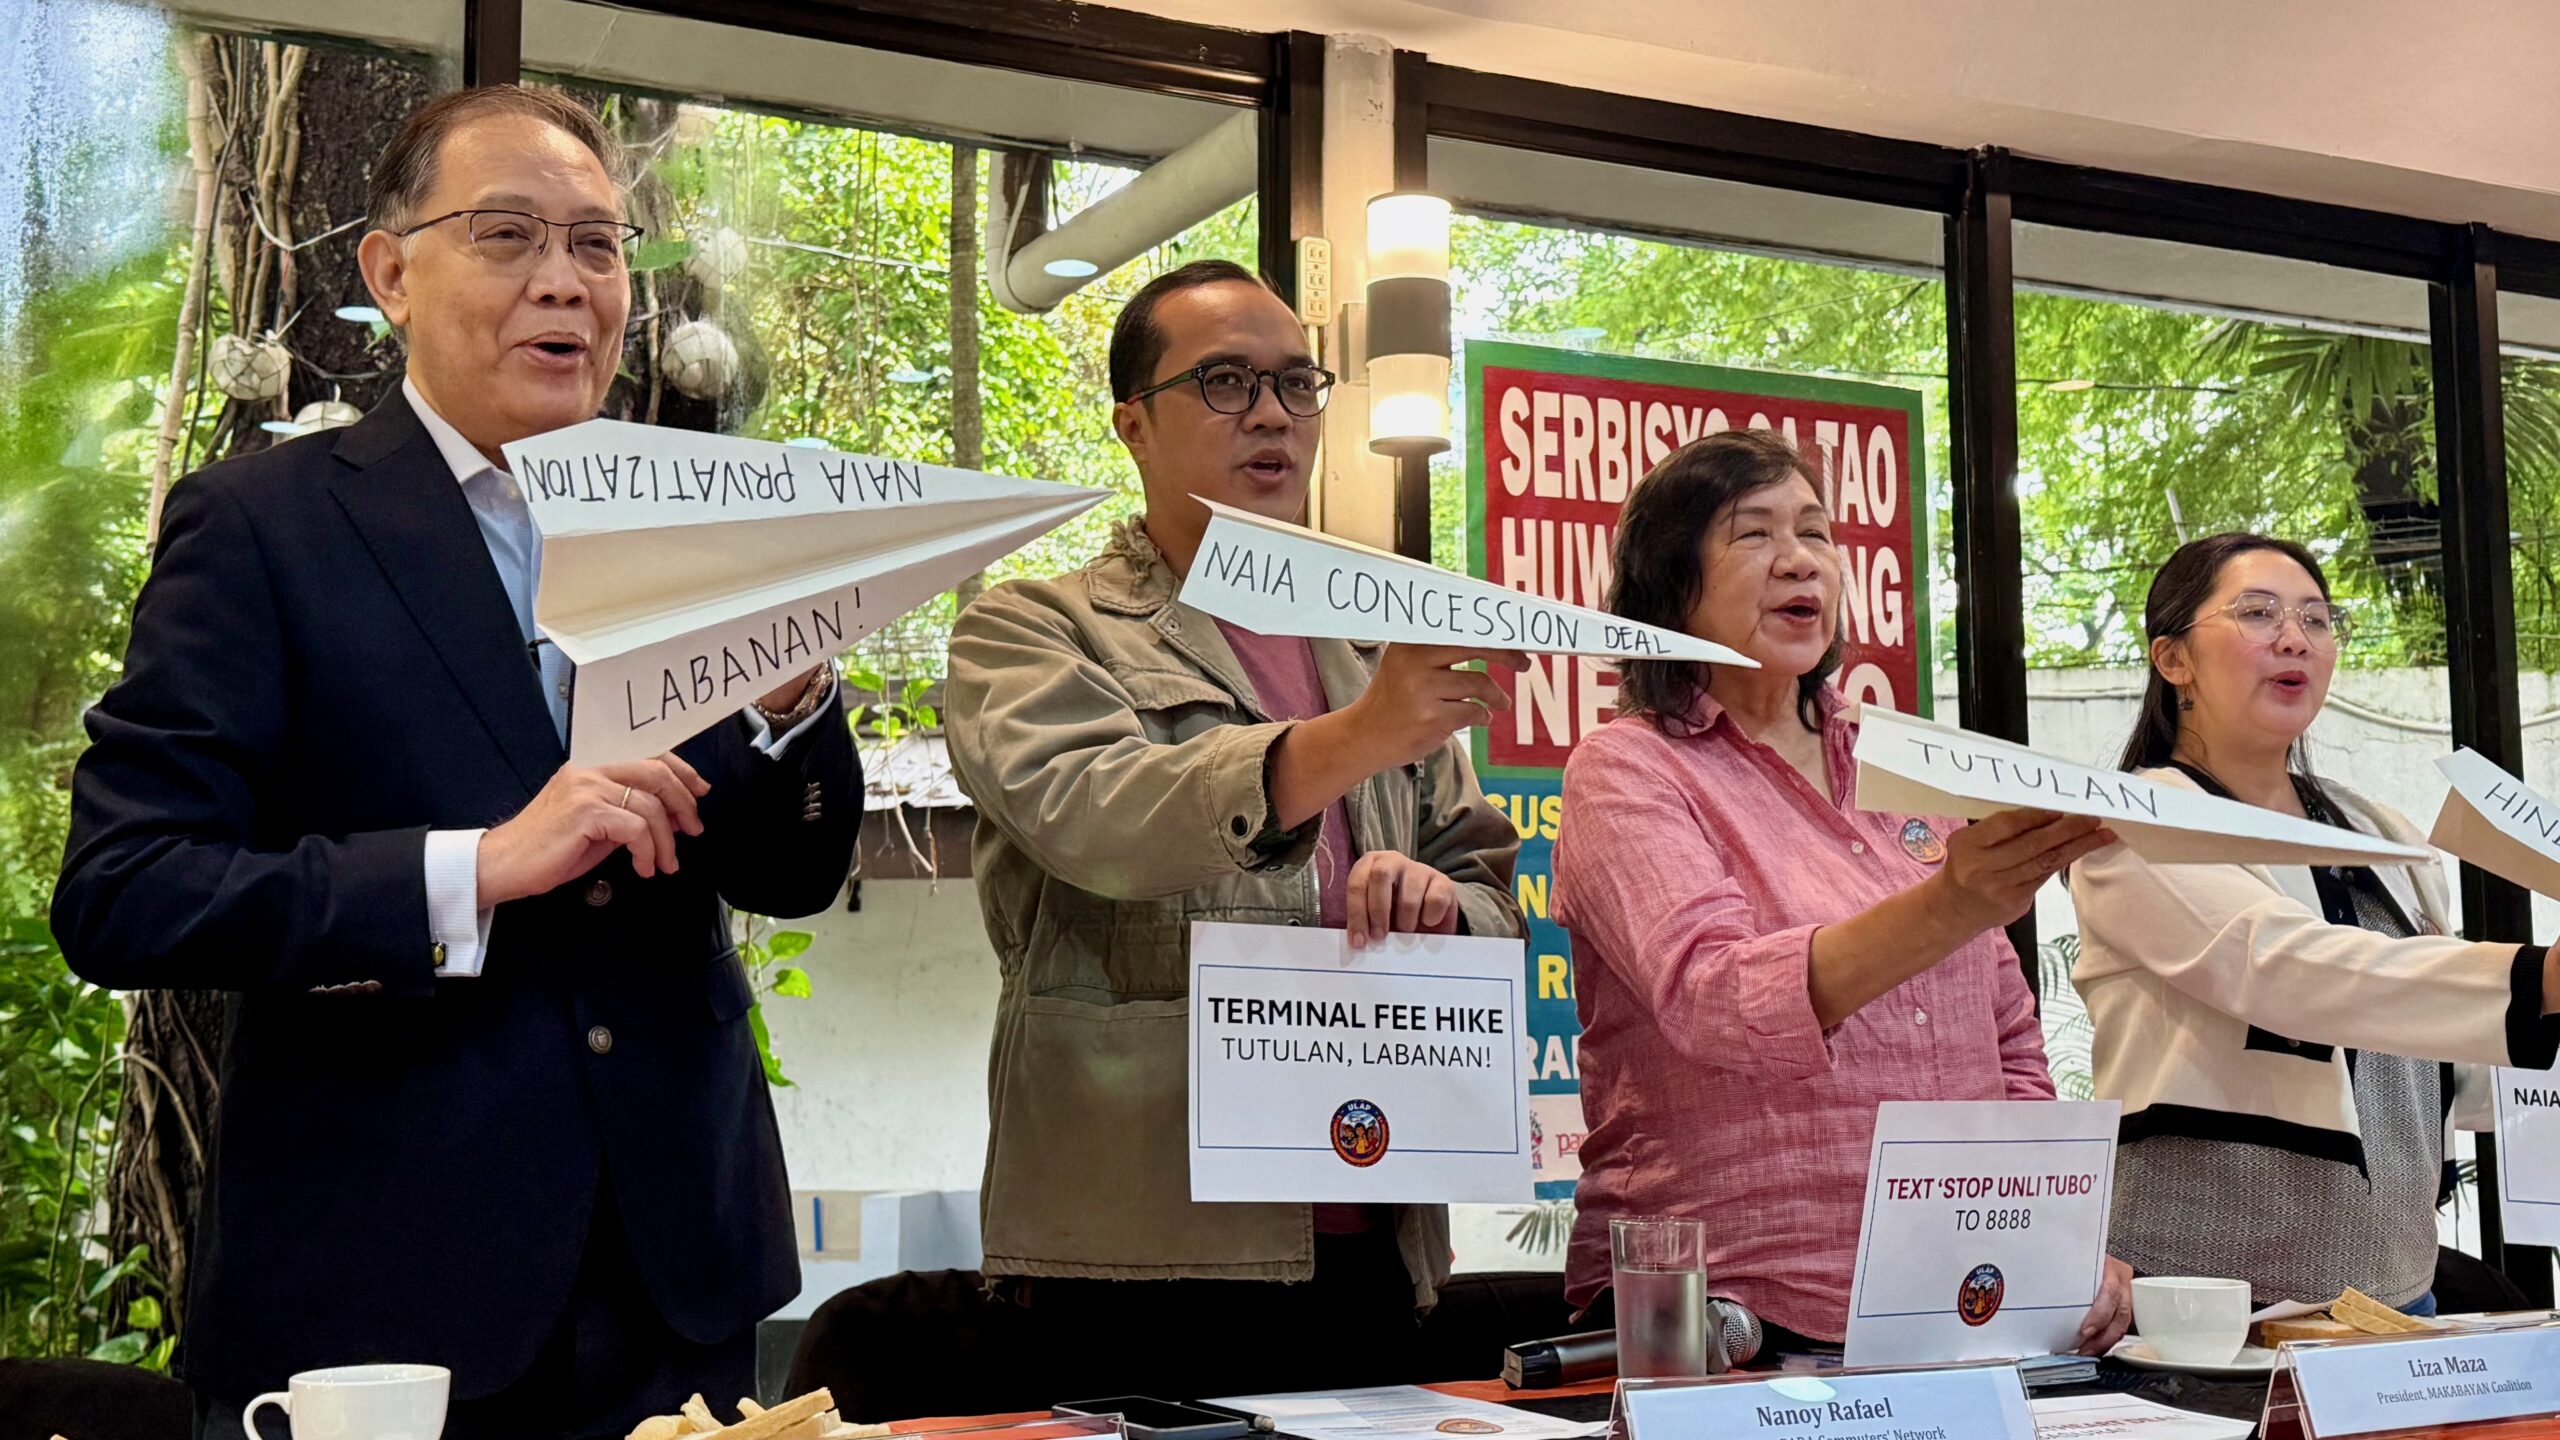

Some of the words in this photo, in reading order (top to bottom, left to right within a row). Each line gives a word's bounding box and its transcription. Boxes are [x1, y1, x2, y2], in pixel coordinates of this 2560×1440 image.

[1500, 387, 1730, 504] SERBIS
[1815, 420, 1897, 528] TAO
[818, 457, 923, 504] NAIA
[1203, 540, 1296, 603] NAIA
[1326, 567, 1579, 650] CONCESSION
[1604, 623, 1672, 655] DEAL
[626, 585, 865, 732] LABANAN!
[1906, 737, 2159, 819] TUTULAN
[2484, 781, 2560, 847] HIN
[1208, 996, 1366, 1029] TERMINAL
[1374, 1003, 1427, 1031] FEE
[1436, 1006, 1504, 1034] HIKE
[1221, 1037, 1353, 1068] TUTULAN,
[1362, 1041, 1492, 1069] LABANAN!
[1347, 1102, 1372, 1112] ULAP
[2513, 1087, 2560, 1108] NAIA
[1887, 1177, 1935, 1200] TEXT
[1998, 1175, 2042, 1198] UNLI
[1955, 1209, 1980, 1232] TO
[1986, 1208, 2031, 1231] 8888
[2407, 1358, 2443, 1378] Liza
[2444, 1355, 2488, 1375] Maza
[2376, 1389, 2427, 1405] President,
[2427, 1381, 2490, 1400] MAKABAYAN
[2490, 1379, 2532, 1395] Coalition
[1756, 1405, 1822, 1429] Nanoy
[1826, 1397, 1894, 1422] Rafael
[1893, 1426, 1947, 1440] Network
